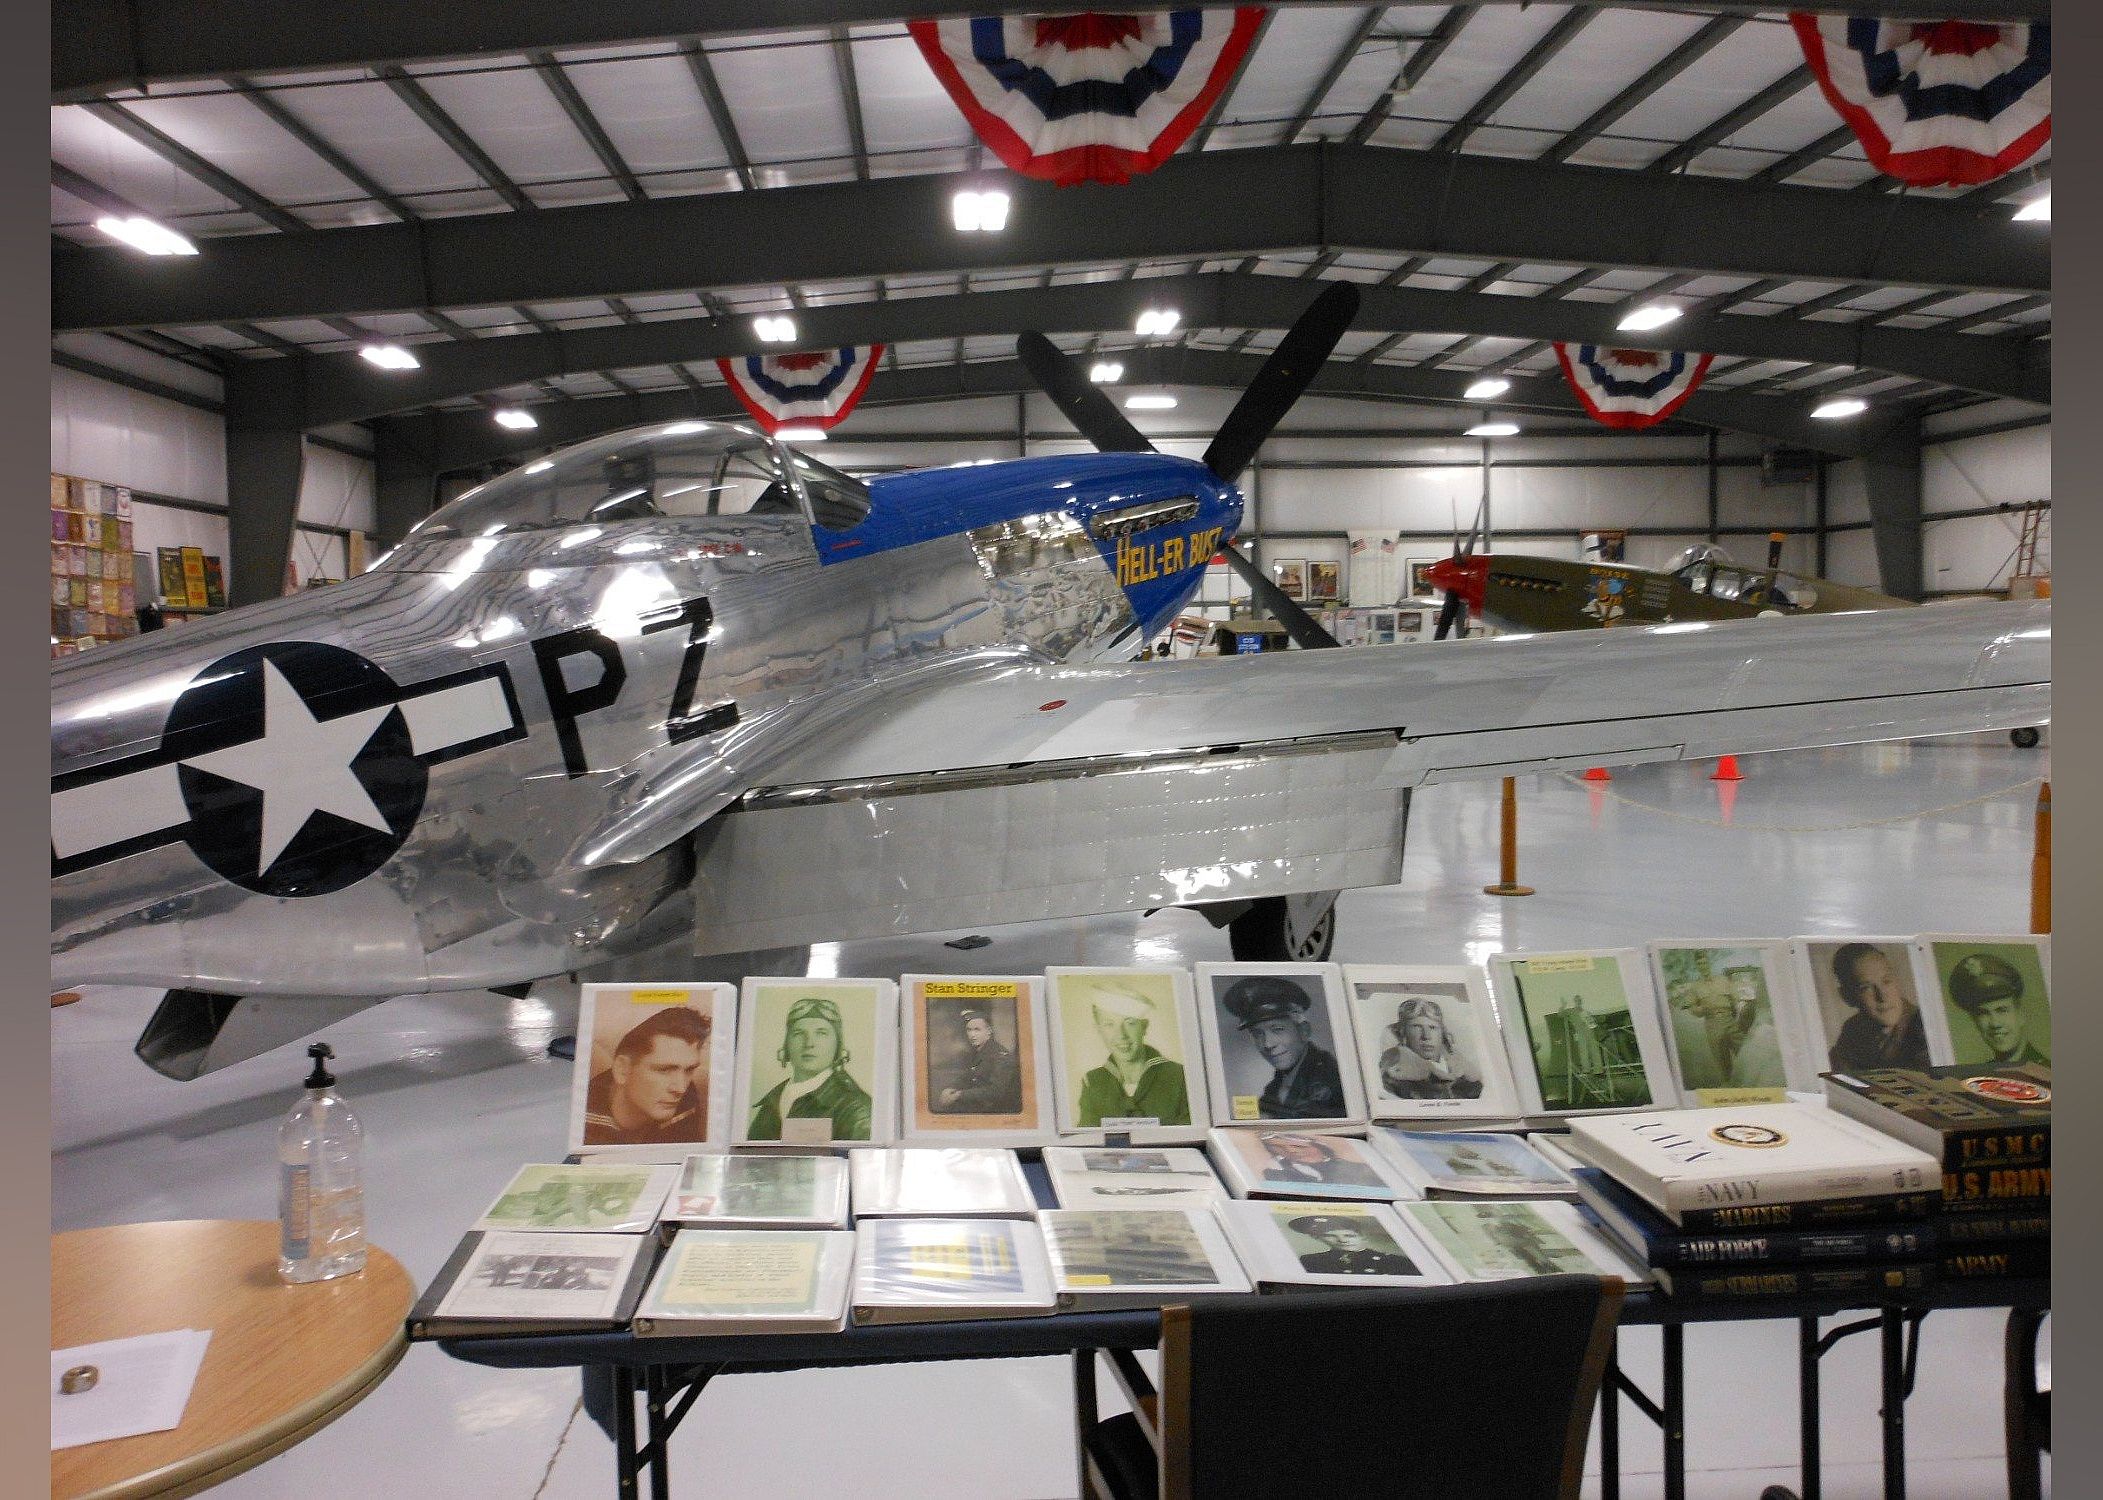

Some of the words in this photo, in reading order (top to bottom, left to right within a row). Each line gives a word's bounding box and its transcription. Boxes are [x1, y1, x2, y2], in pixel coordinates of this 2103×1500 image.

[1116, 534, 1185, 588] HELL-ER
[925, 982, 955, 994] Stan
[958, 982, 1012, 996] Stringer
[1705, 1180, 1760, 1201] NAVY
